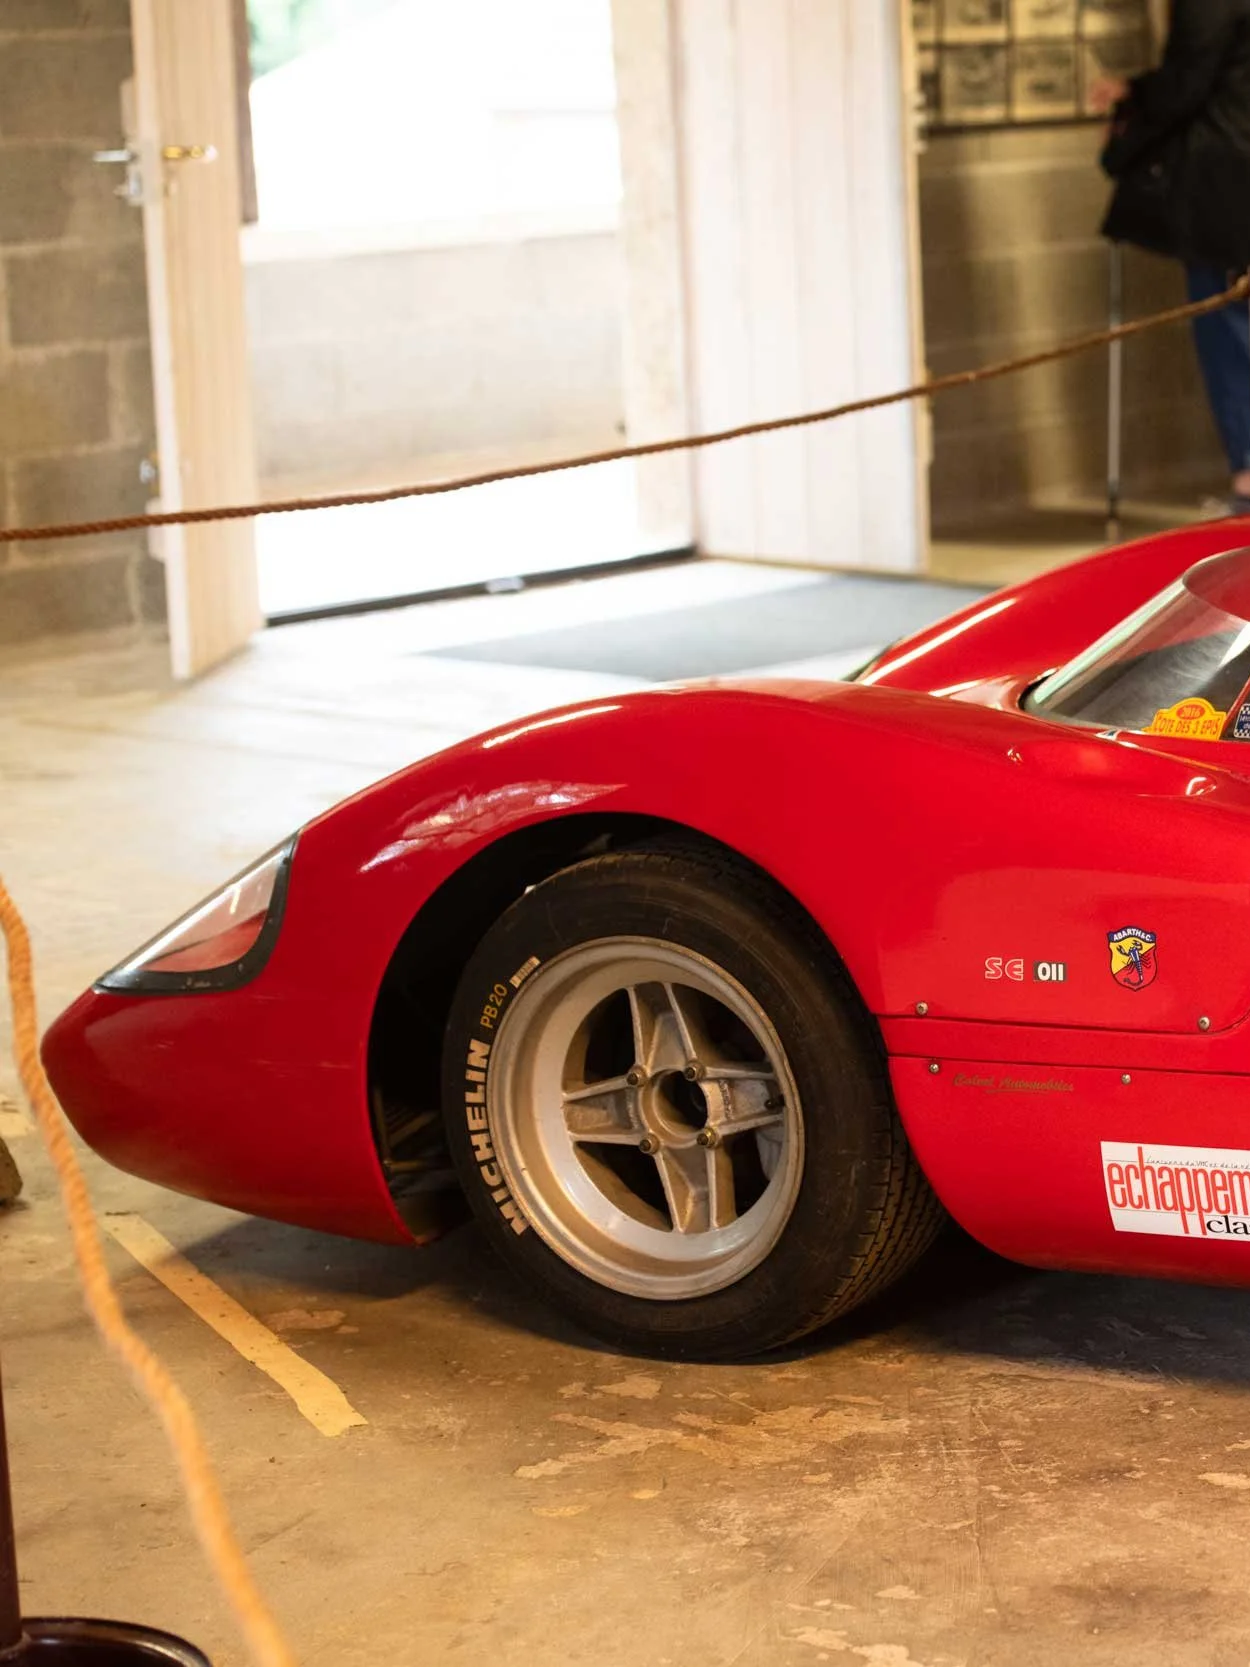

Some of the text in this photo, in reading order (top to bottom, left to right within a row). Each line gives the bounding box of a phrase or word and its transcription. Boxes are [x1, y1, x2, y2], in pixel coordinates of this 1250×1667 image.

[1176, 719, 1190, 734] DES
[1192, 719, 1200, 735] 3
[984, 957, 1025, 981] SE
[464, 1038, 530, 1236] MICHELIN
